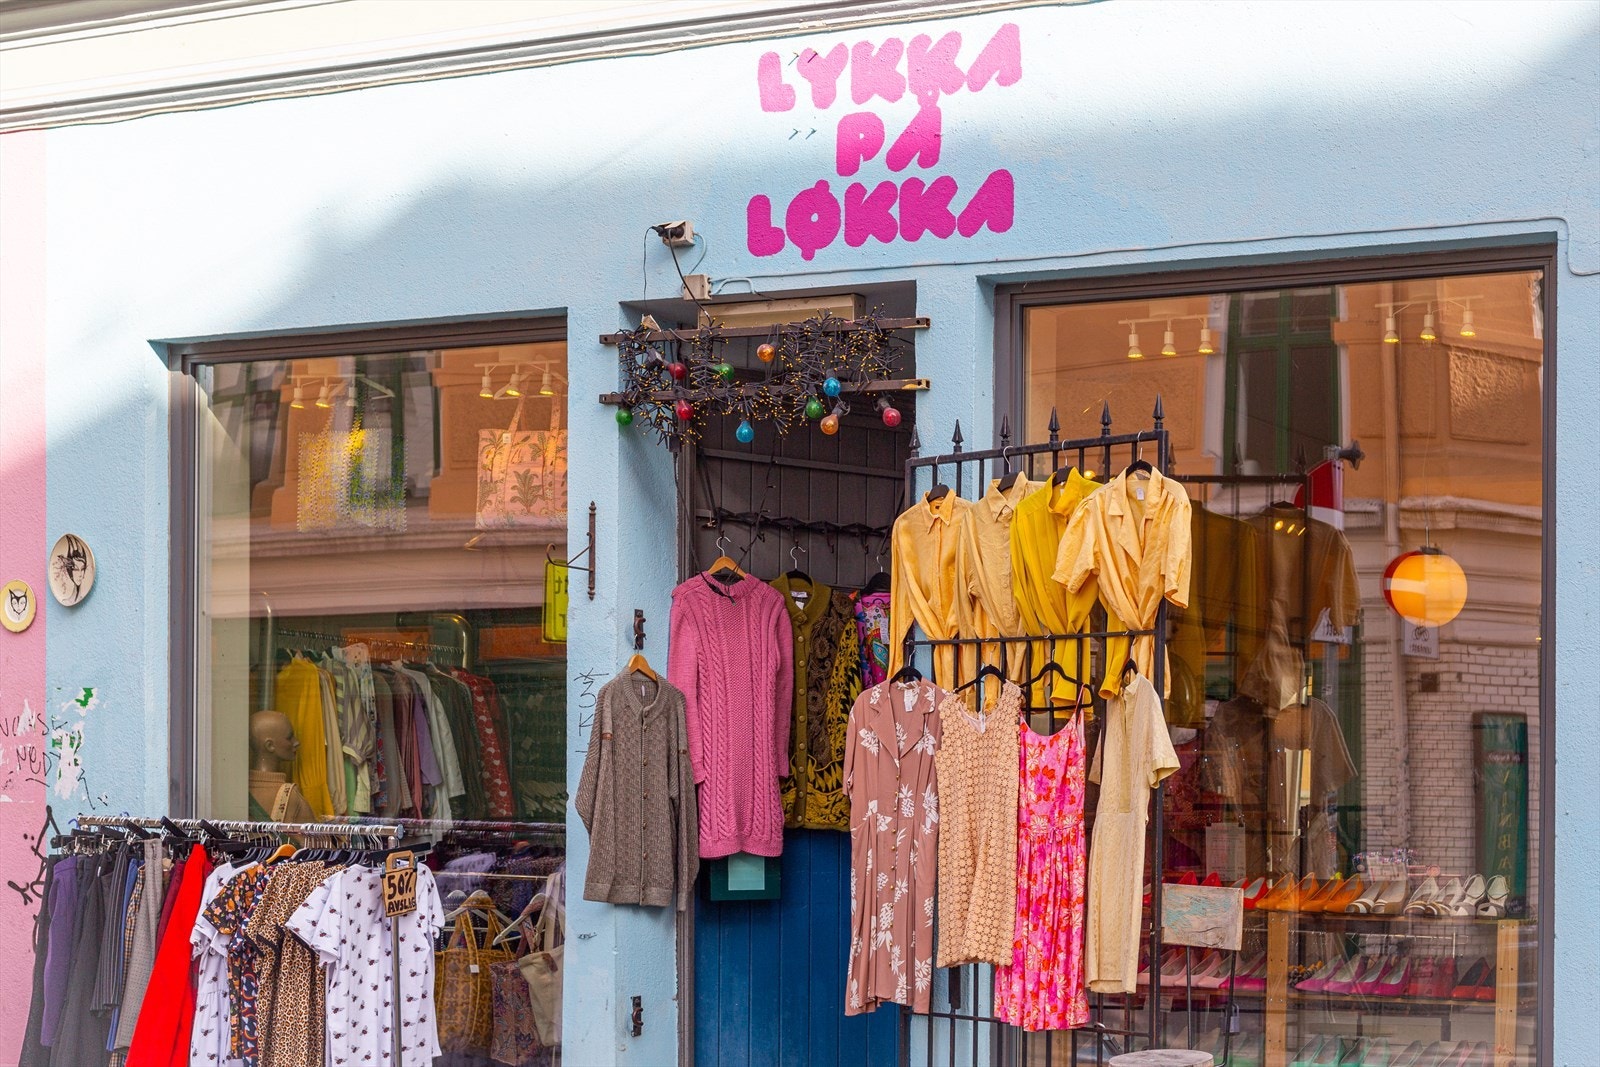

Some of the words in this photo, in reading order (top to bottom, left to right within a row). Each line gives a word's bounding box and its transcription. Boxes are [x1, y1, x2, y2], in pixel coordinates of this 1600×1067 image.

[757, 23, 1022, 112] LYKKA
[836, 86, 942, 177] PÅ
[747, 169, 1015, 261] LØKKA
[387, 871, 414, 900] 50%
